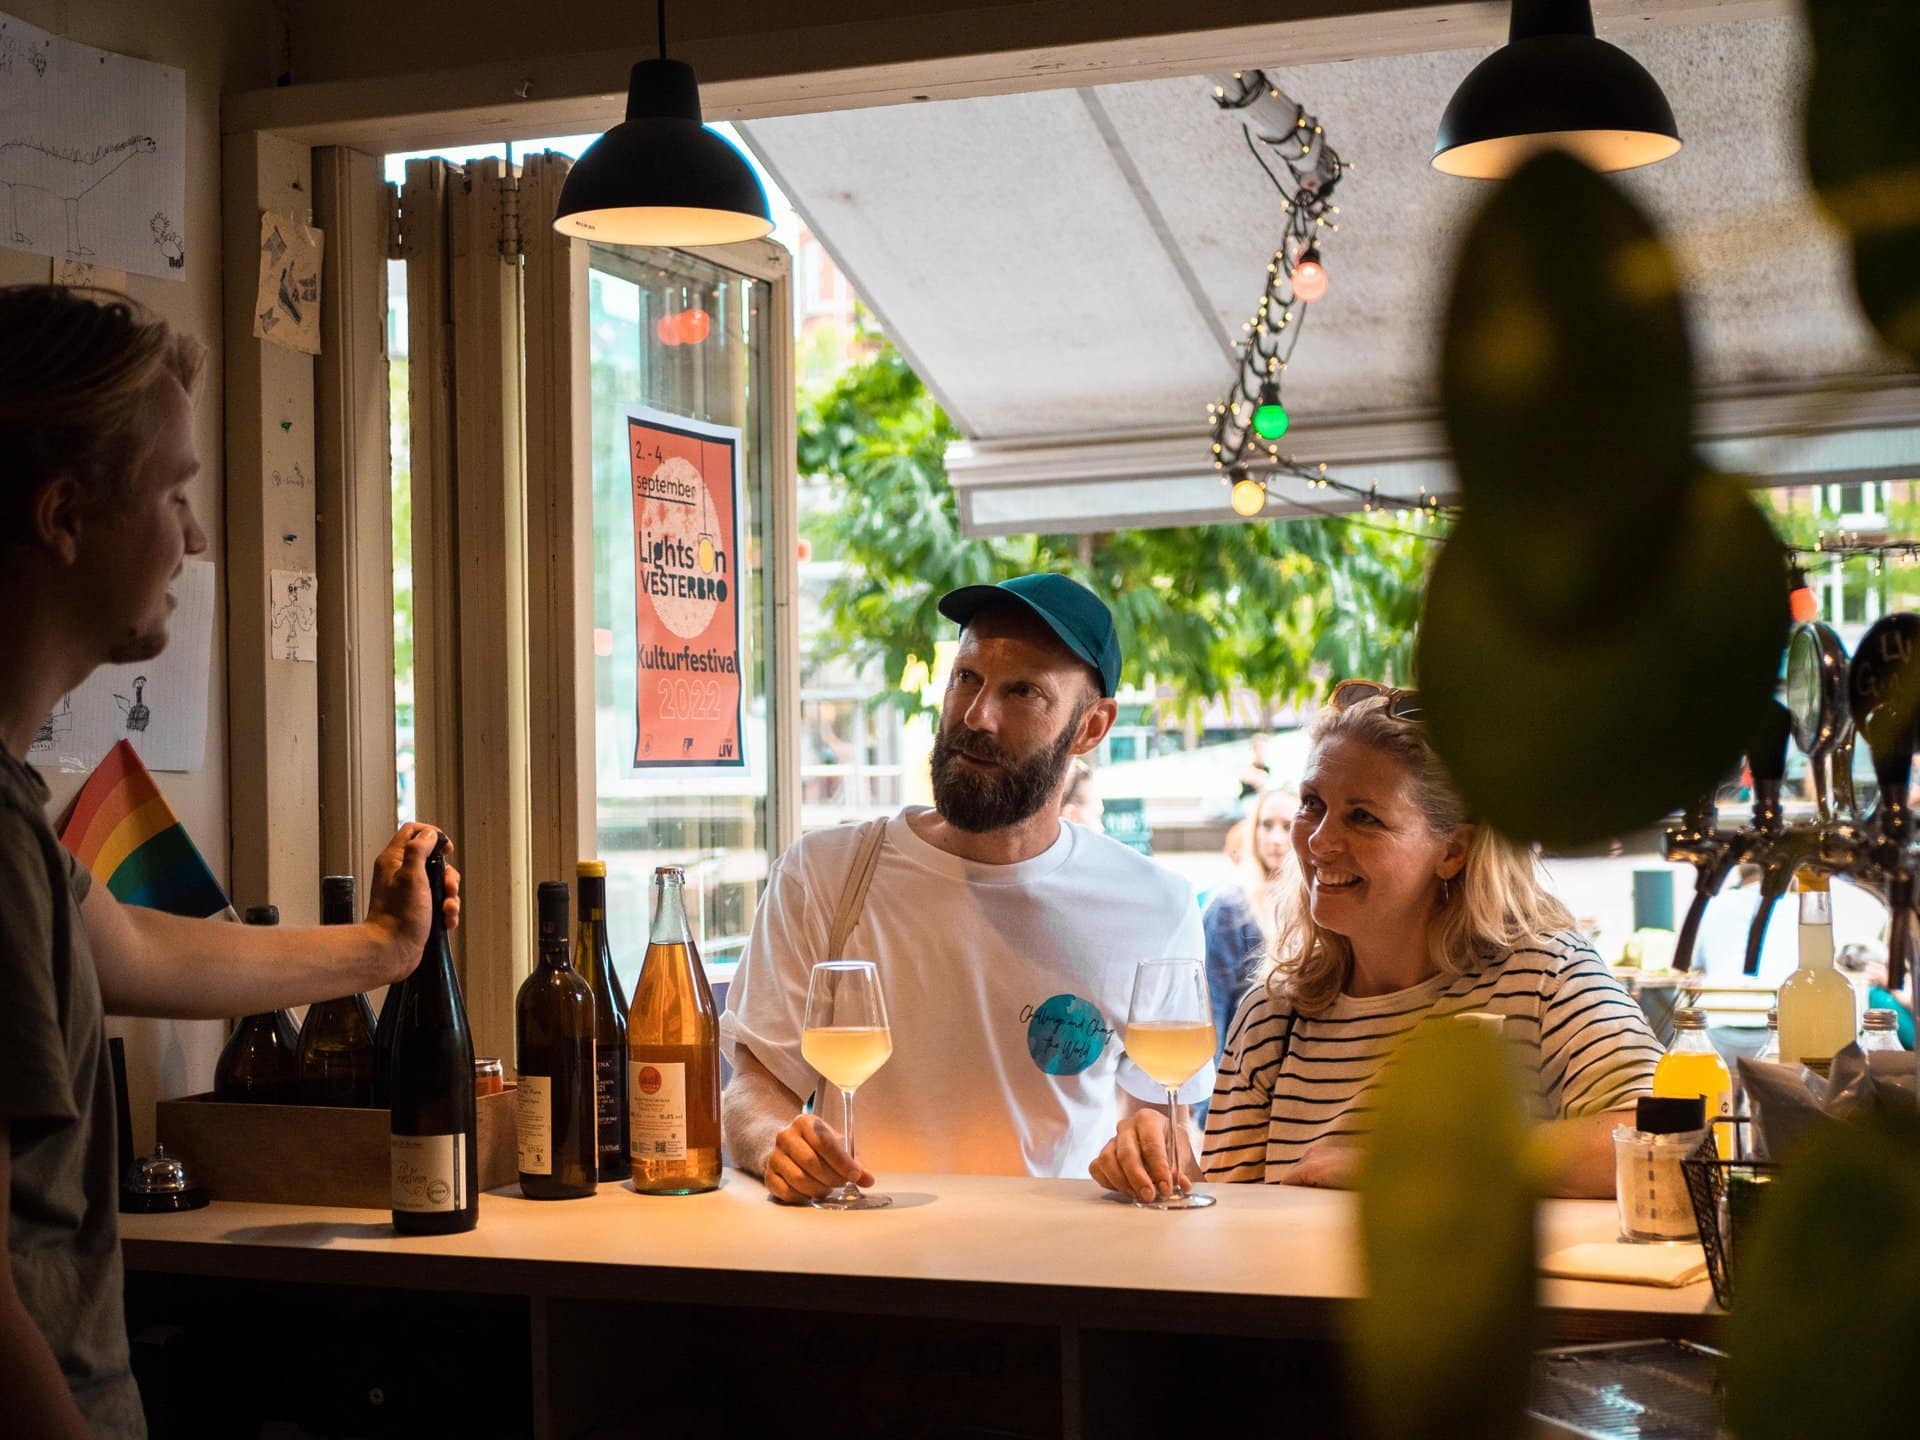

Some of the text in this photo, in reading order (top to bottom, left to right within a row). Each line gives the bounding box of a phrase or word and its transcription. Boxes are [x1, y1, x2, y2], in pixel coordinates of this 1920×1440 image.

[636, 474, 696, 499] september
[639, 530, 695, 574] Lights
[641, 570, 727, 602] VESTERBRO
[638, 645, 739, 674] Kulturfestival
[658, 678, 721, 720] 2022
